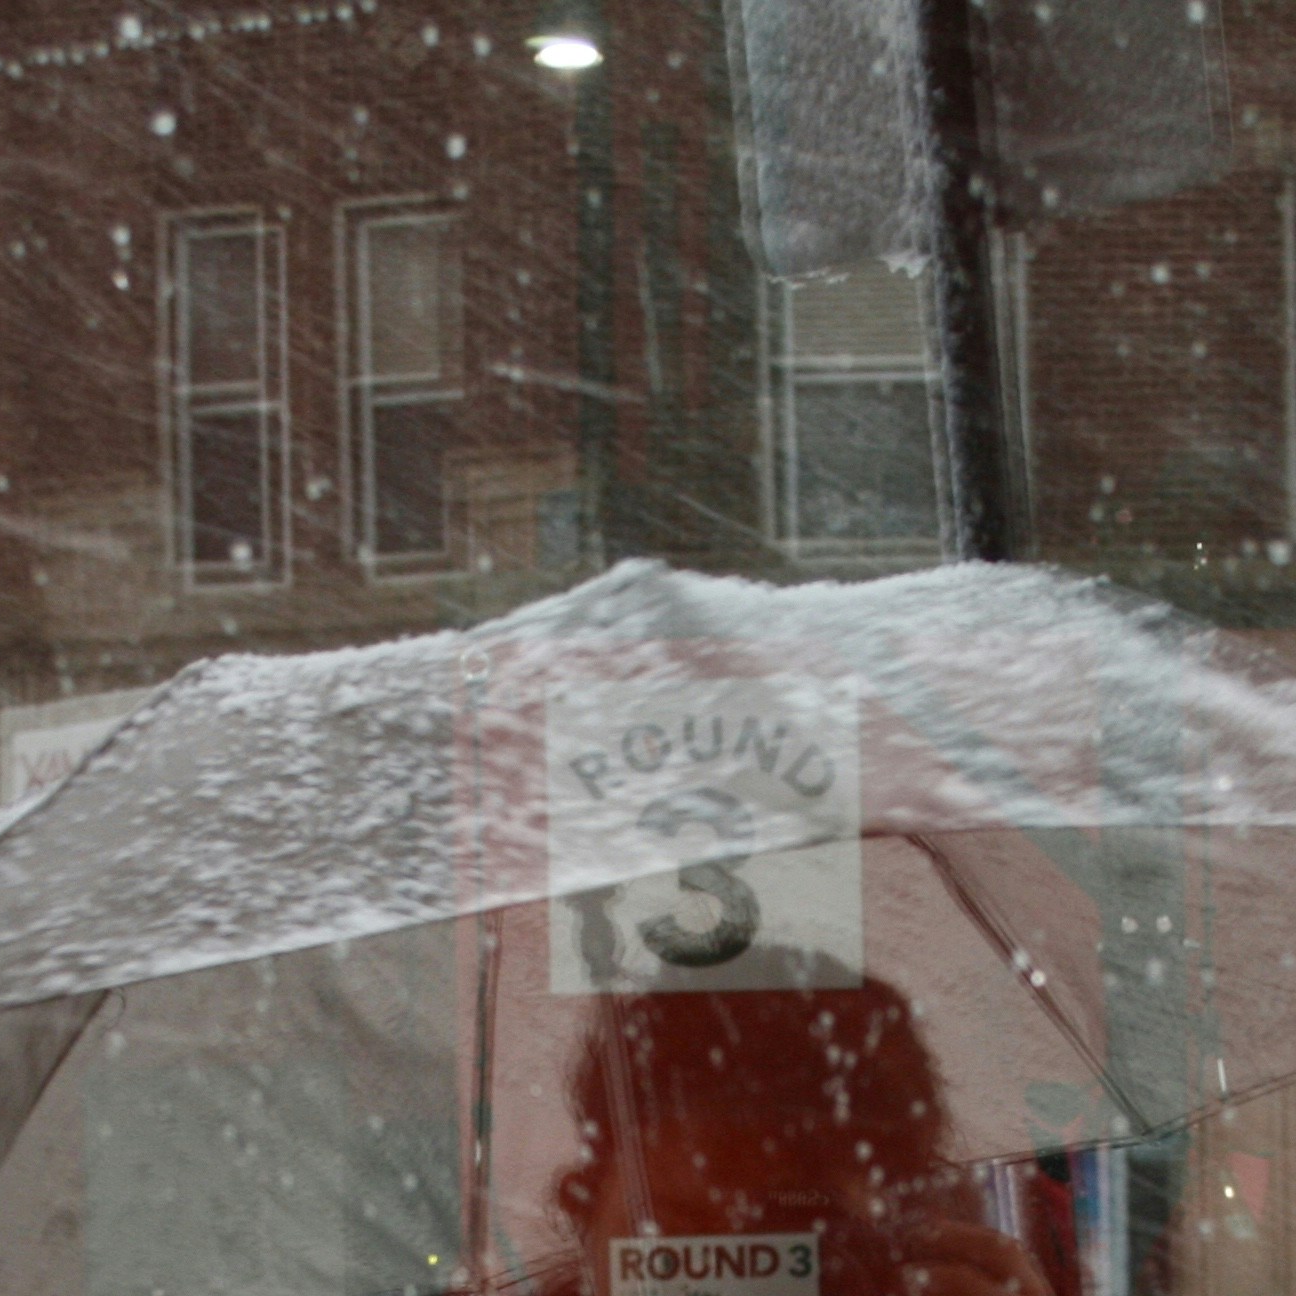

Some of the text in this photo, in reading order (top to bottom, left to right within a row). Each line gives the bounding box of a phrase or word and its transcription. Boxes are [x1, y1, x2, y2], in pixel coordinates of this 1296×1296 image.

[569, 715, 837, 800] ROUND
[636, 787, 761, 968] 3
[620, 1243, 813, 1282] ROUND 3
